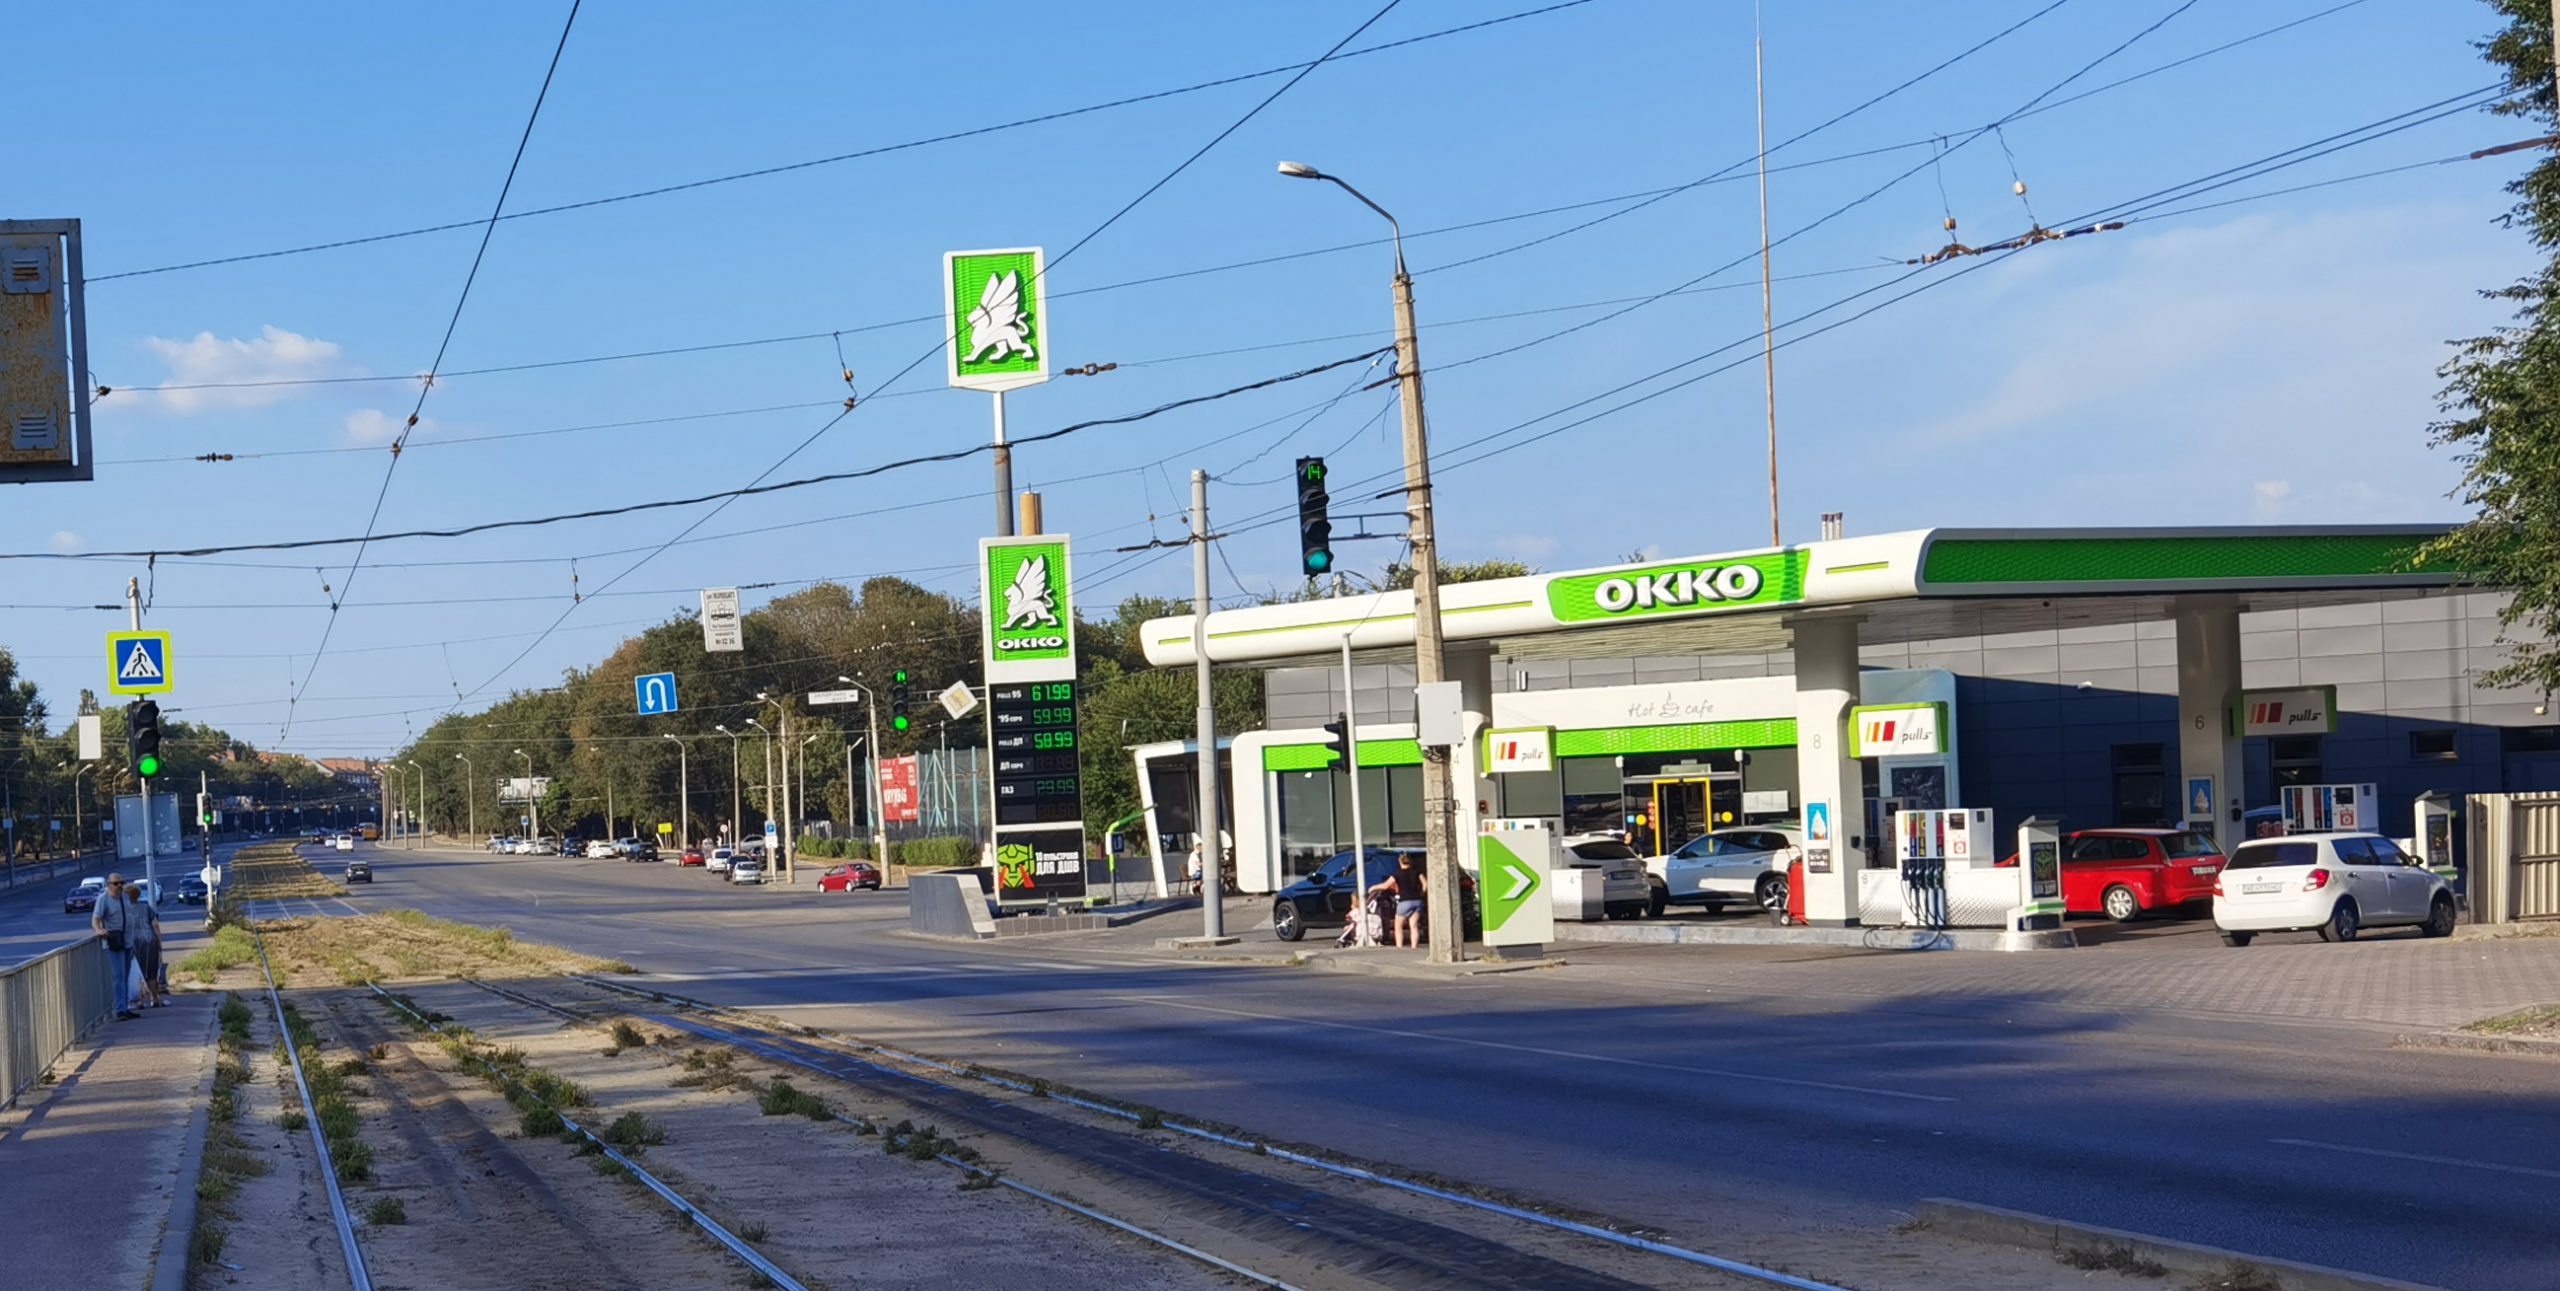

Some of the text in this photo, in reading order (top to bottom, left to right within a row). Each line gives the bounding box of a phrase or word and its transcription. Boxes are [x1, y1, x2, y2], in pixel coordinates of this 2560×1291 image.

[1307, 465, 1320, 480] 14
[1594, 564, 1760, 612] OKKO
[997, 636, 1063, 650] OKKO
[1012, 690, 1022, 699] 95
[1032, 683, 1072, 701] 61.99
[1034, 707, 1073, 725] 59.99
[1628, 699, 1714, 718] Hot cafe
[2195, 714, 2205, 730] 6
[2288, 708, 2322, 726] pulls
[1034, 731, 1074, 749] 58.99
[1813, 734, 1821, 749] 8
[1901, 728, 1933, 744] pulls
[1521, 747, 1544, 763] pulls
[1001, 785, 1014, 794] ГАЗ
[1036, 861, 1055, 876] ДЛЯ
